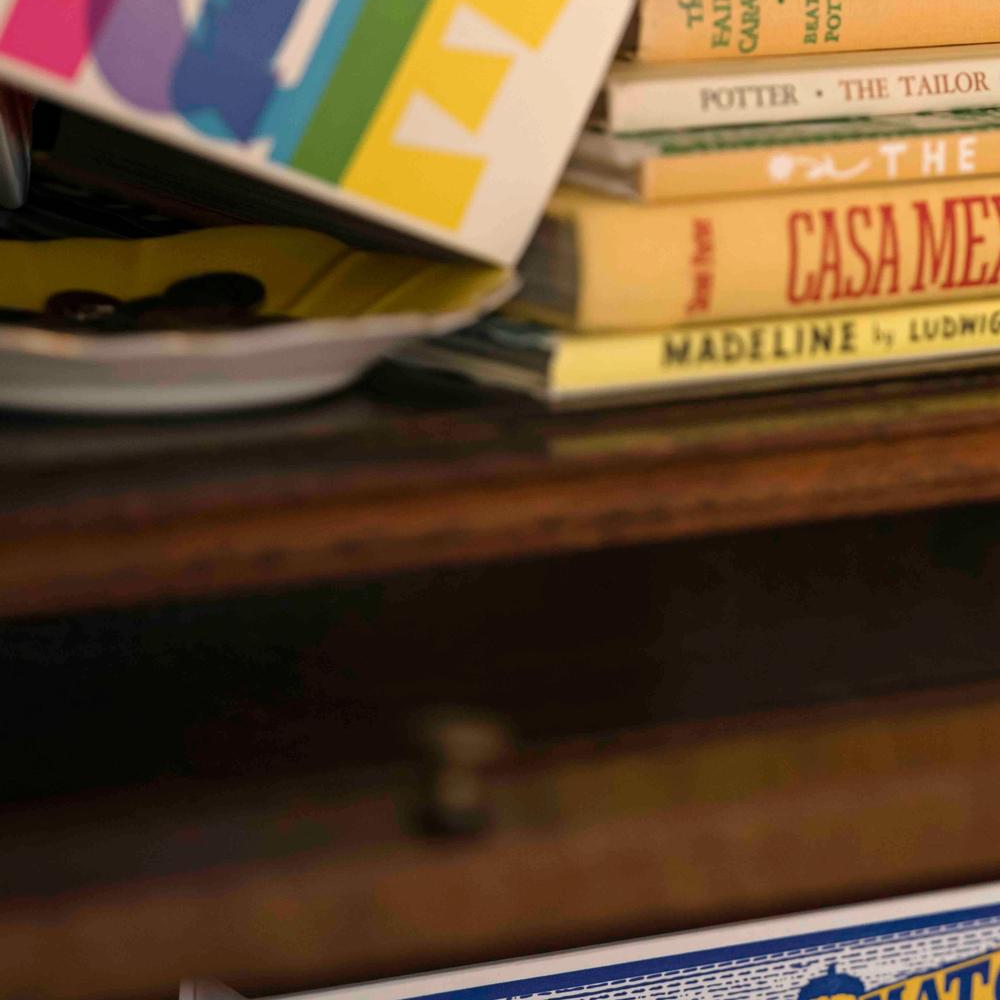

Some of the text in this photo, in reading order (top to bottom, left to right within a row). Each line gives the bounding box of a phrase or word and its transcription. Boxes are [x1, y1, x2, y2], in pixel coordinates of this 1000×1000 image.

[699, 84, 799, 111] POTTER
[838, 77, 890, 101] THE
[898, 70, 990, 98] TAILOR
[879, 136, 977, 177] THE
[786, 203, 899, 306] CASA
[661, 321, 857, 365] MADELINE
